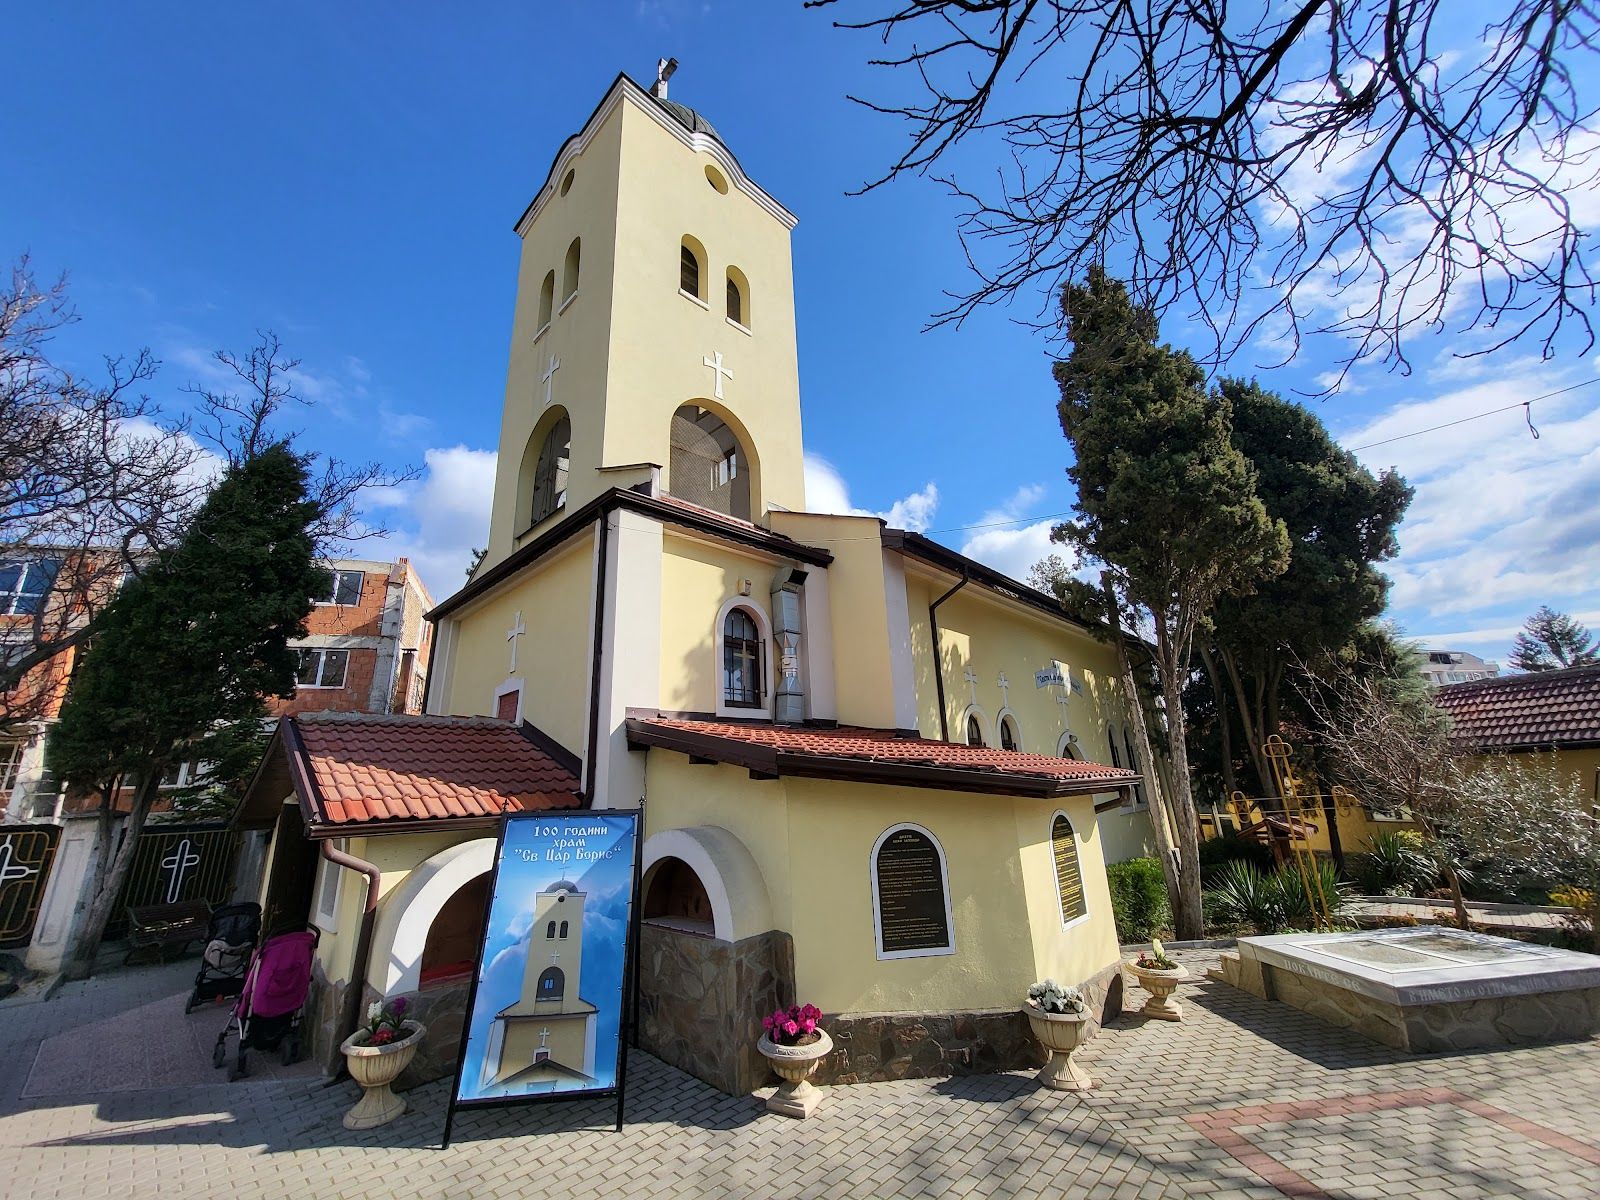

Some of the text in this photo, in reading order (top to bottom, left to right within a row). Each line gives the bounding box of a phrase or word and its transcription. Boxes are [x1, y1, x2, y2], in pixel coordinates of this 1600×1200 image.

[534, 826, 608, 837] 100 години
[552, 838, 586, 850] храм
[546, 849, 570, 864] Цар
